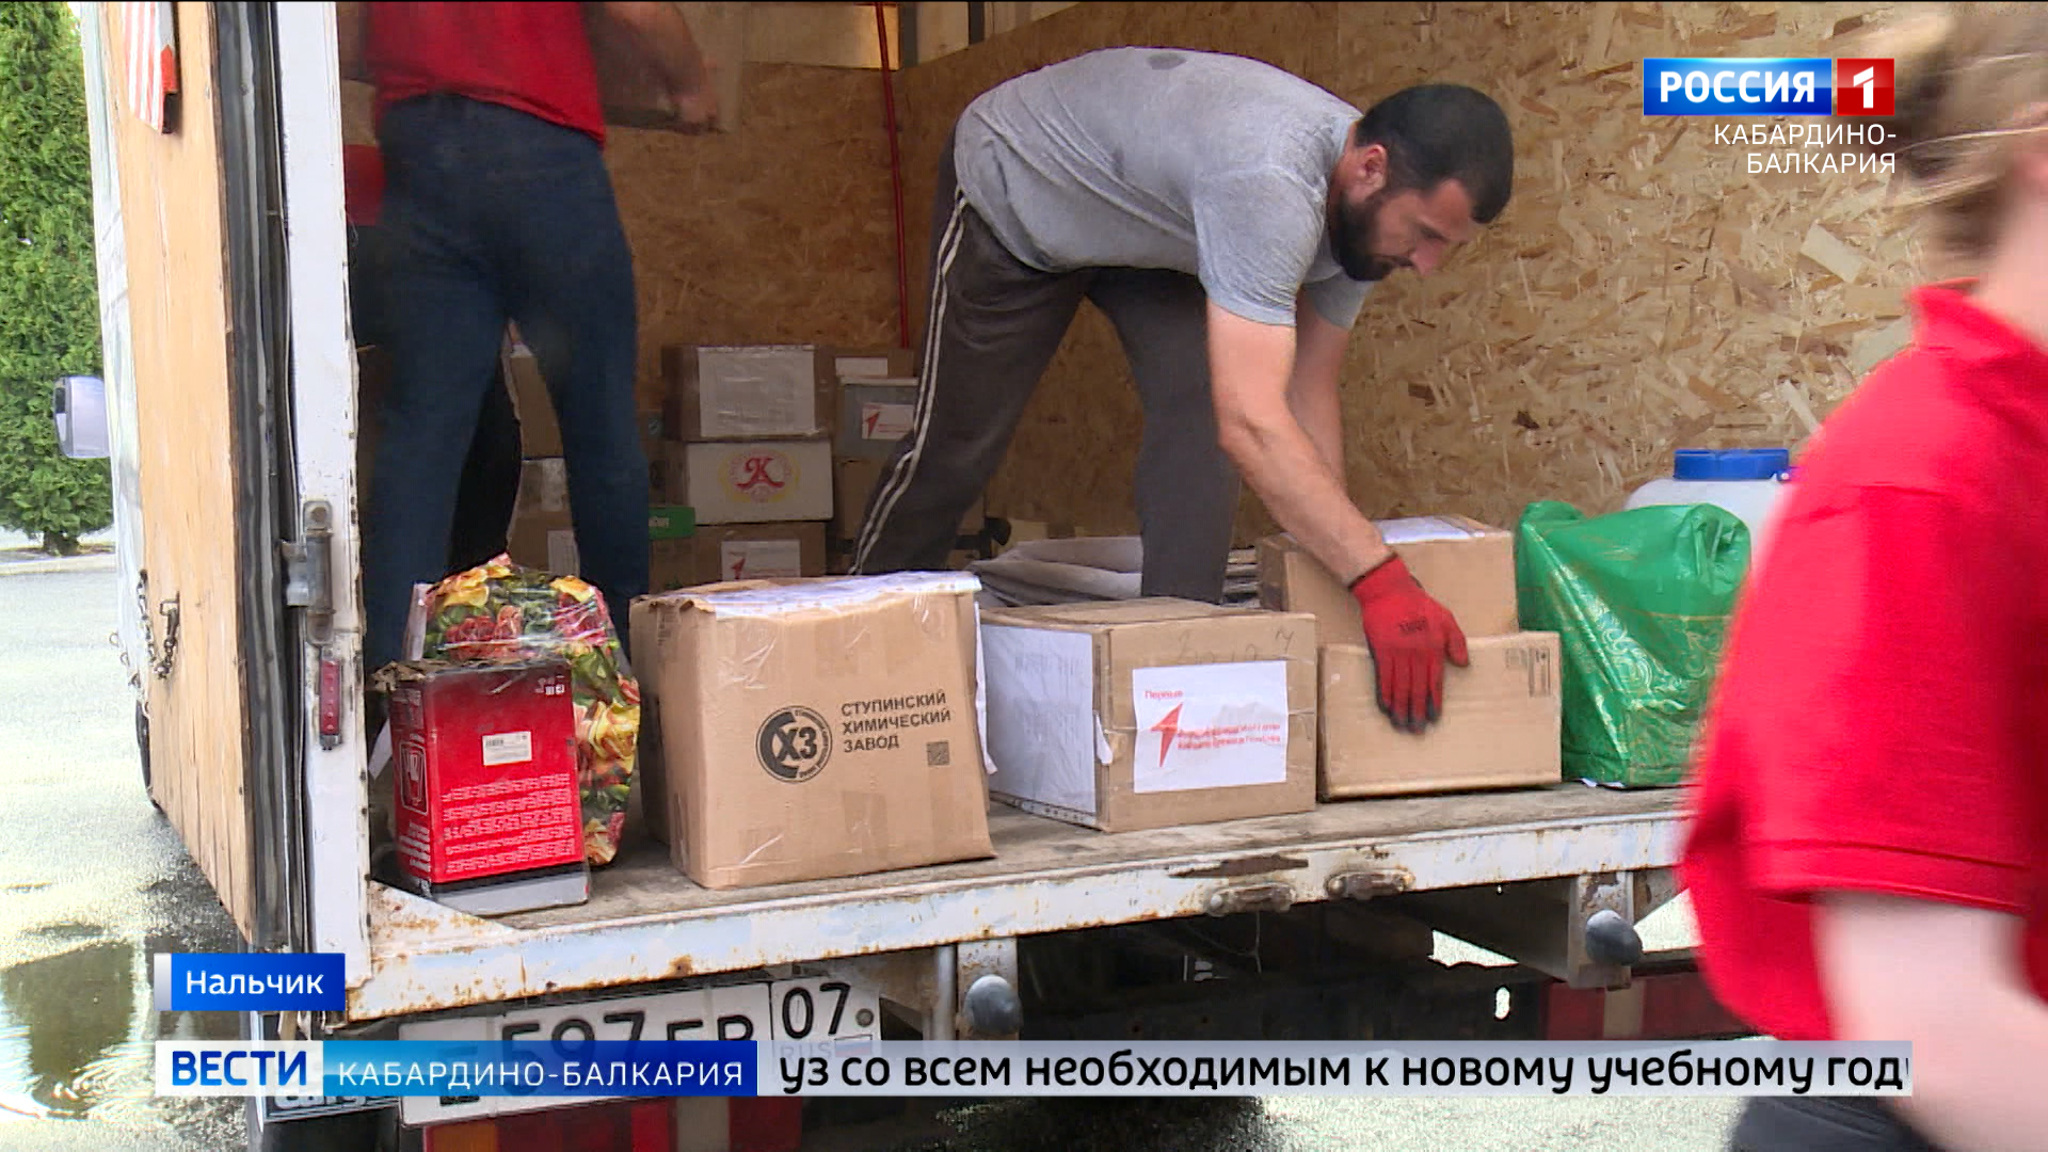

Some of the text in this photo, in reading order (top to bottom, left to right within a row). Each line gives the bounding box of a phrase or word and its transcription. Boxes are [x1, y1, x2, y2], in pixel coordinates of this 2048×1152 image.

[841, 689, 947, 717] СТУПИНСКИЙ
[842, 708, 952, 735] ХИМИЧЕСКИЙ
[844, 735, 899, 753] ЗАВОД
[781, 981, 852, 1040] 07
